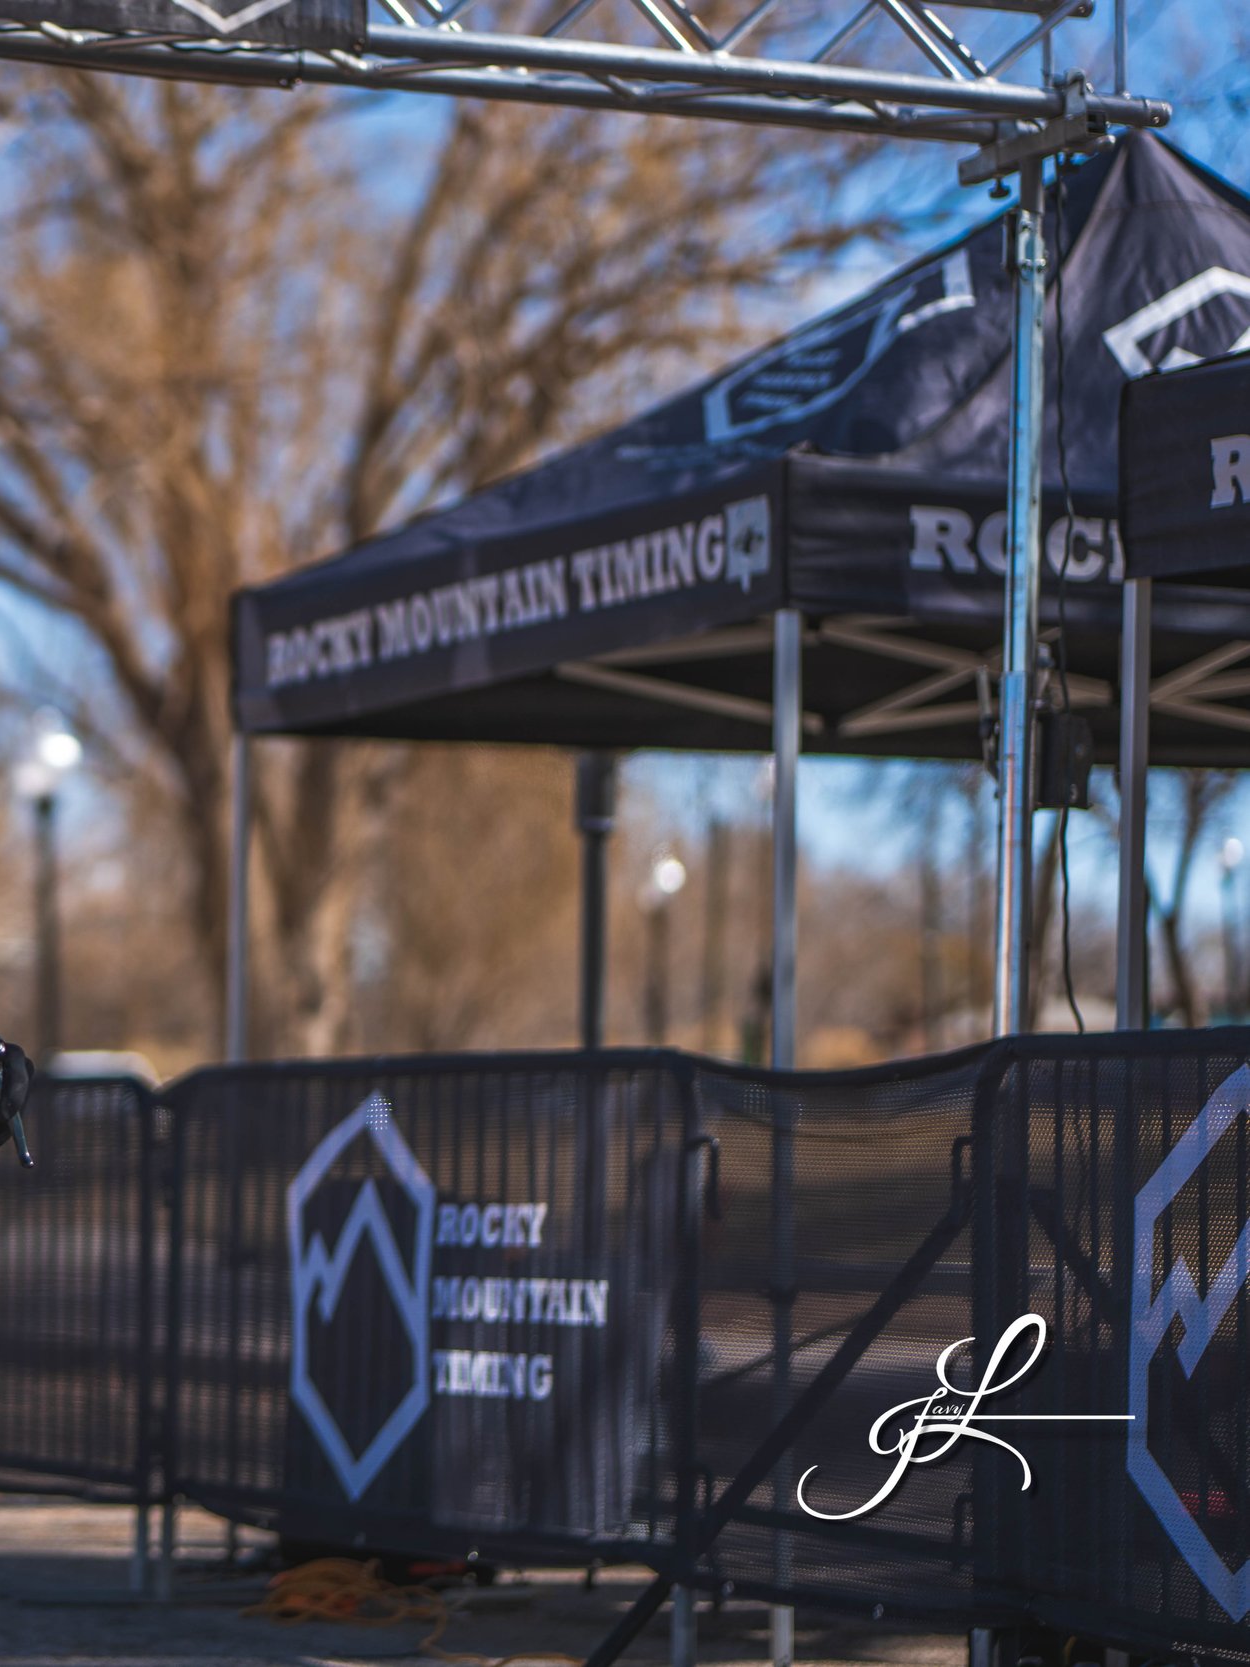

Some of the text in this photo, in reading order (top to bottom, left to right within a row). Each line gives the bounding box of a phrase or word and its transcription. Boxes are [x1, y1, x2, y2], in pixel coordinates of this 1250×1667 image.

[266, 516, 725, 687] ROCKY MOUNTAIN TIMING
[436, 1202, 548, 1248] ROCKY
[434, 1277, 609, 1327] MOUNTAIN
[433, 1351, 553, 1399] TIMING
